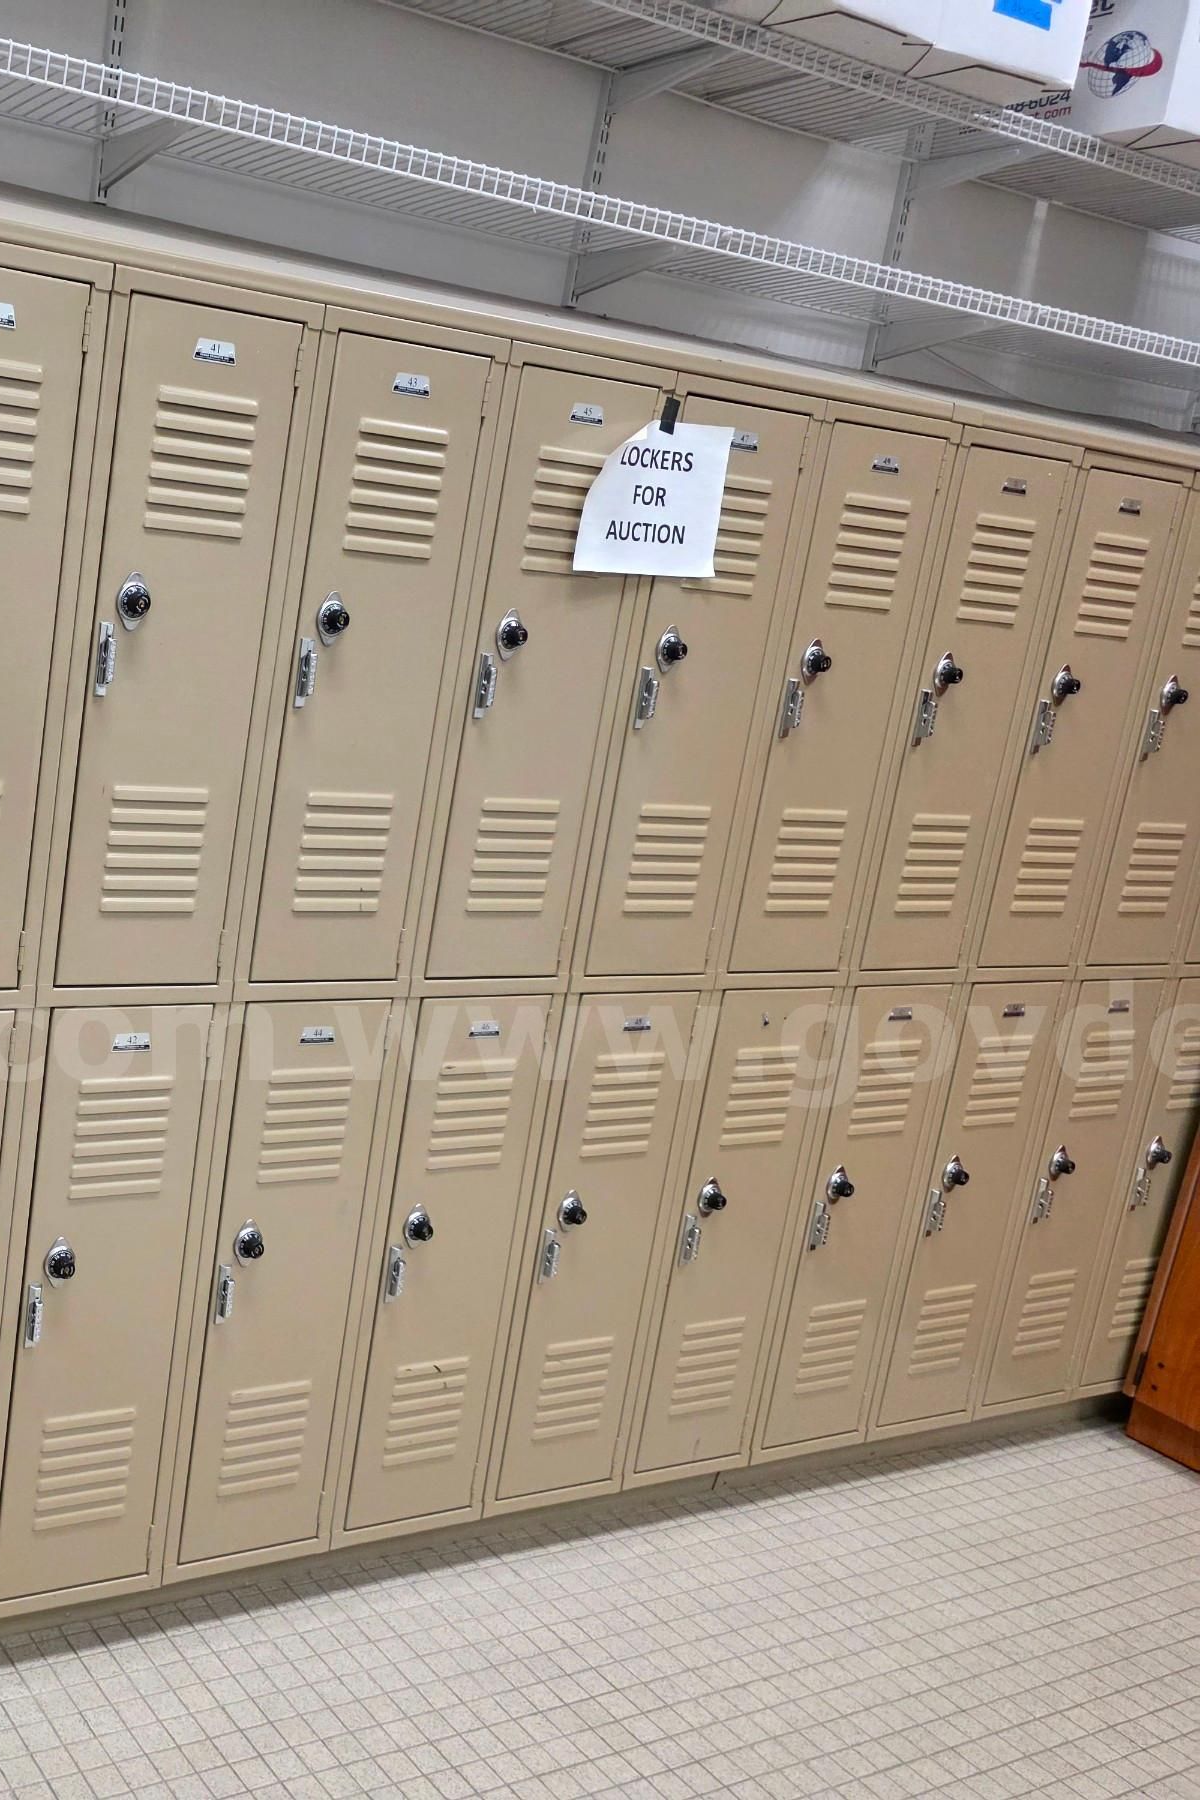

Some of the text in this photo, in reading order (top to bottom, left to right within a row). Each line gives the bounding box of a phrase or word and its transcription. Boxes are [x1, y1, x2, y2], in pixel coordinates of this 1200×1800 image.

[210, 343, 220, 354] 41
[583, 407, 593, 416] 45
[620, 445, 694, 472] LOCKERS
[633, 484, 667, 507] FOR
[606, 520, 686, 545] AUCTION
[312, 1028, 323, 1037] 44
[127, 1035, 138, 1044] 42
